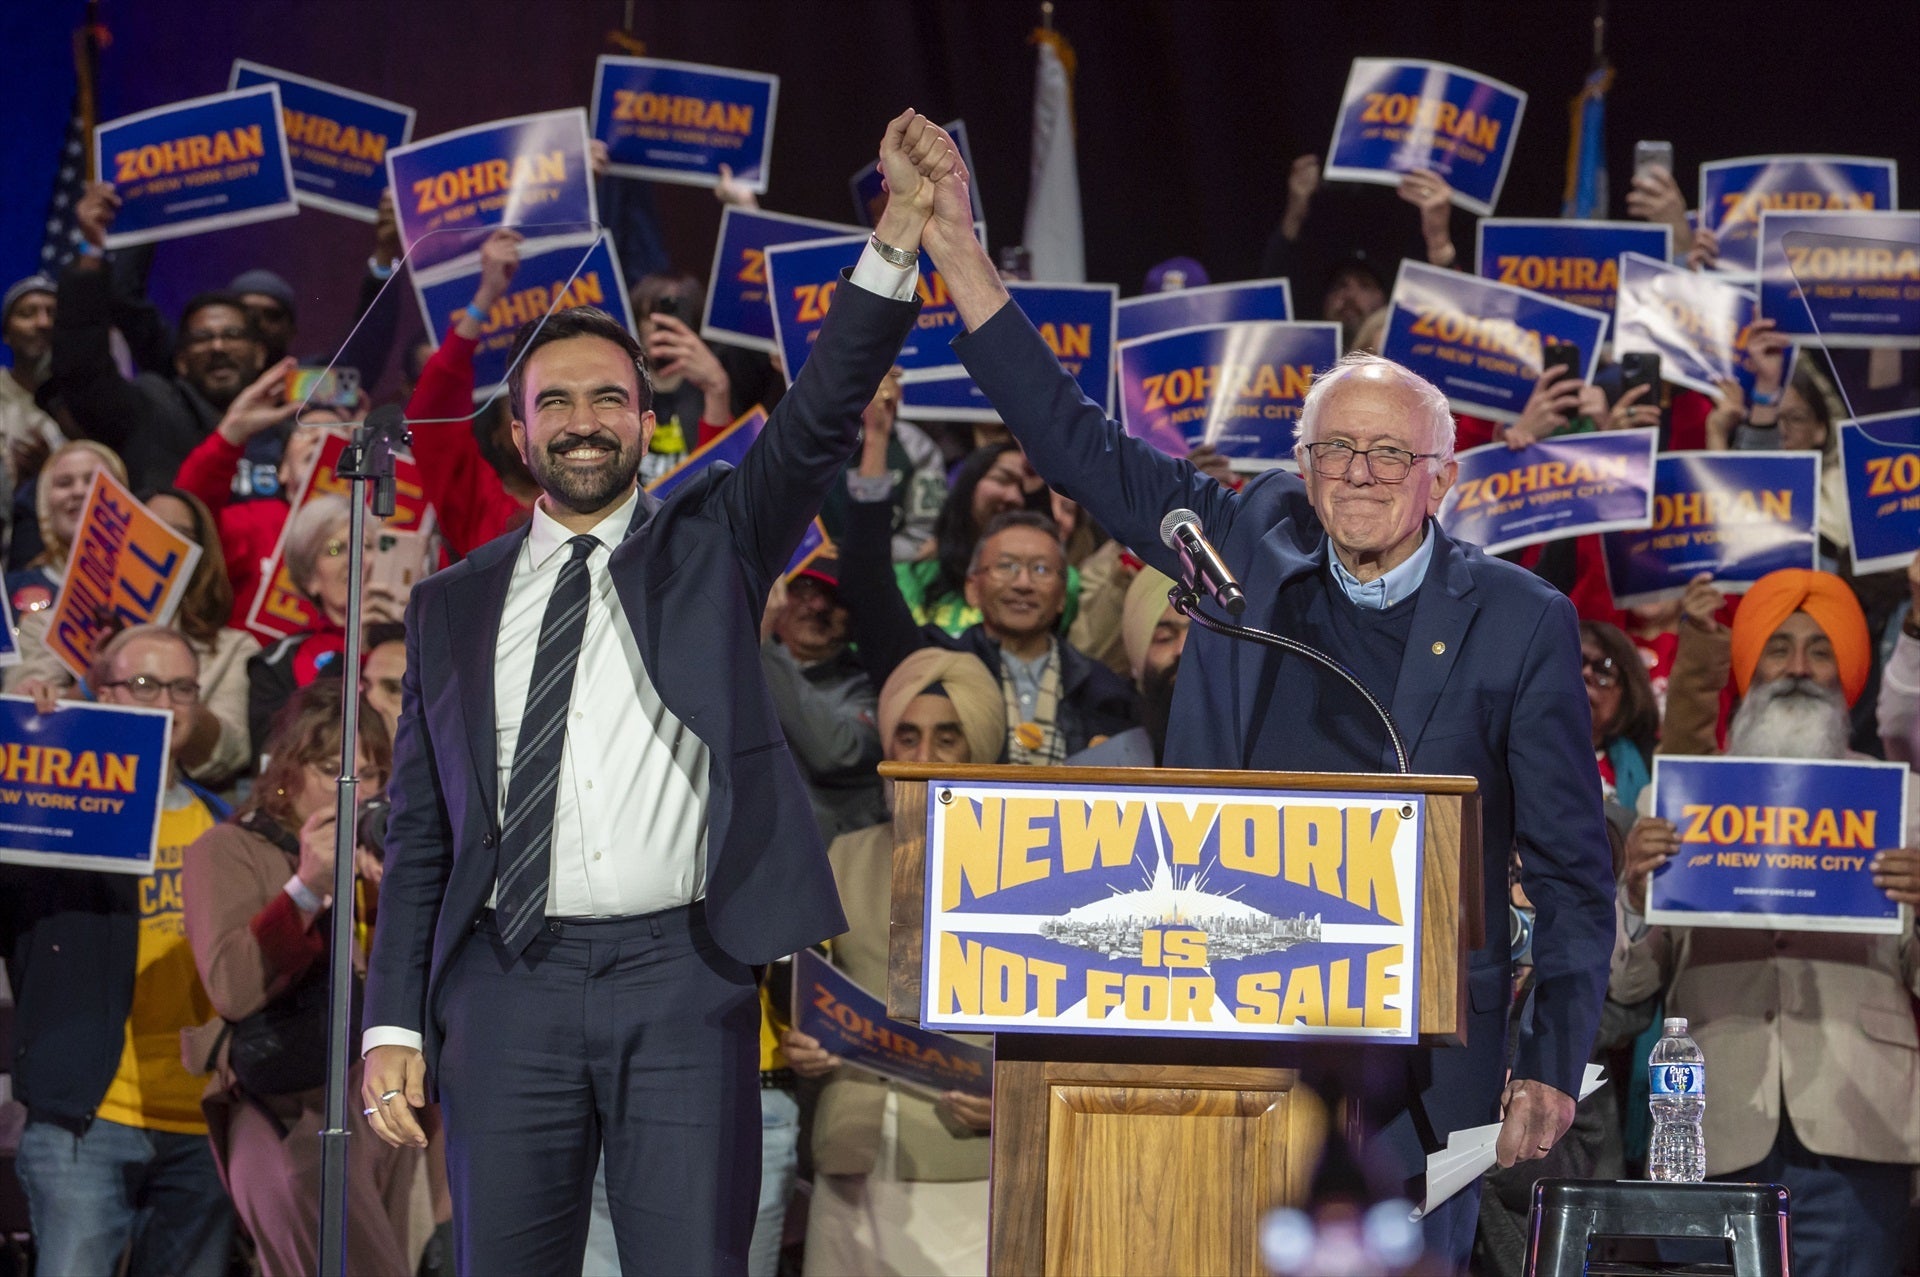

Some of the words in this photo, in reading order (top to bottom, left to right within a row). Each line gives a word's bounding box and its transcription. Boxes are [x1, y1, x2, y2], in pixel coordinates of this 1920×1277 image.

[283, 107, 387, 164] HRAN
[613, 89, 754, 136] ZOHRAN
[1361, 92, 1500, 151] ZOHRAN
[115, 124, 264, 183] ZOHRAN
[413, 150, 566, 214] ZOHRAN
[1498, 255, 1618, 290] ZOHRA
[1785, 246, 1920, 281] ZOHRA
[917, 311, 957, 329] CITY
[1409, 308, 1573, 360] ZOHRA
[1143, 363, 1313, 413] ZOHRAN
[1456, 454, 1628, 513] ZOHRAN
[1648, 489, 1794, 531] OHRAN
[0, 742, 139, 793] HRAN
[25, 791, 78, 811] YORK
[79, 795, 125, 814] CITY
[1682, 803, 1877, 849] ZOHRAN
[941, 796, 1146, 913] NEW
[1157, 801, 1405, 927] YORK
[1716, 852, 1761, 869] NEW
[1765, 854, 1818, 870] YORK
[1821, 855, 1866, 872] CITY
[1142, 929, 1207, 968] IS
[938, 930, 1067, 1017] NOT
[1086, 969, 1216, 1022] FOR
[1236, 943, 1404, 1028] SALE
[812, 982, 983, 1077] ZOHRAN
[1670, 1065, 1690, 1075] Pure
[1671, 1073, 1688, 1085] Life
